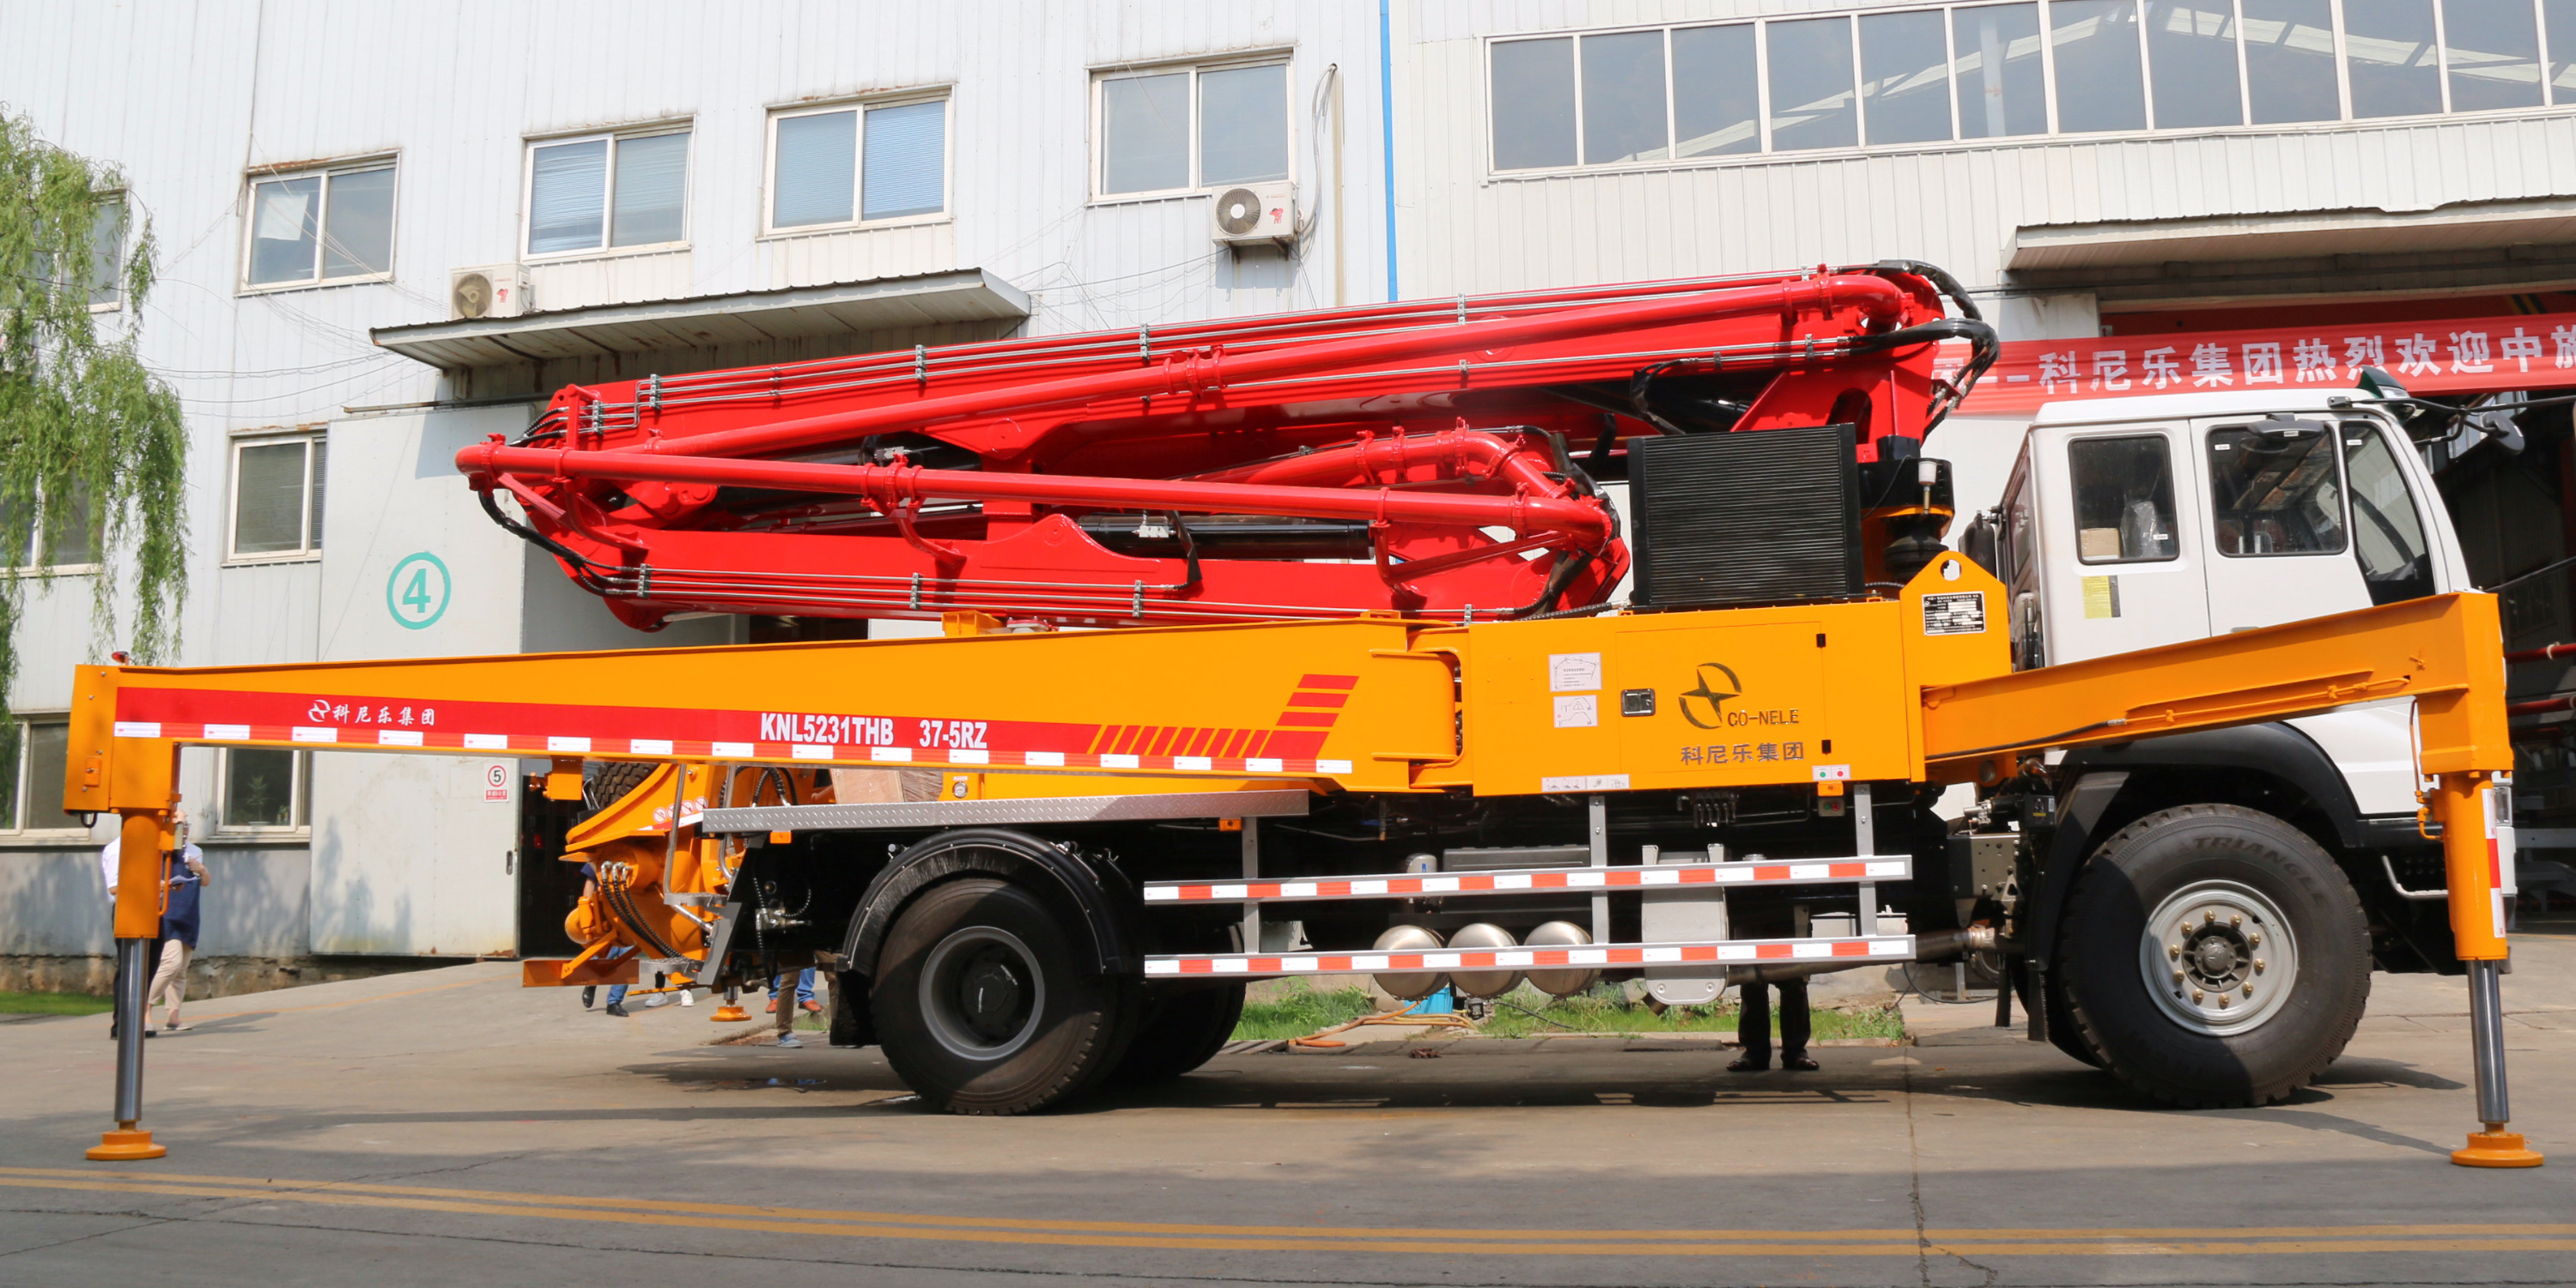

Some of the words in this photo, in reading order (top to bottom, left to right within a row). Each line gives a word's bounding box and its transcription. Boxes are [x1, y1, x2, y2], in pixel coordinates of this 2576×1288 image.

[402, 568, 431, 613] 4
[332, 704, 435, 726] 科尼乐集团
[1727, 708, 1800, 727] CO-NELE
[761, 713, 894, 745] KNL5231THB
[919, 720, 987, 749] 37-5RZ
[1680, 742, 1804, 766] 科尼乐集团
[494, 769, 501, 782] 5
[2193, 835, 2328, 907] TRIANGLE
